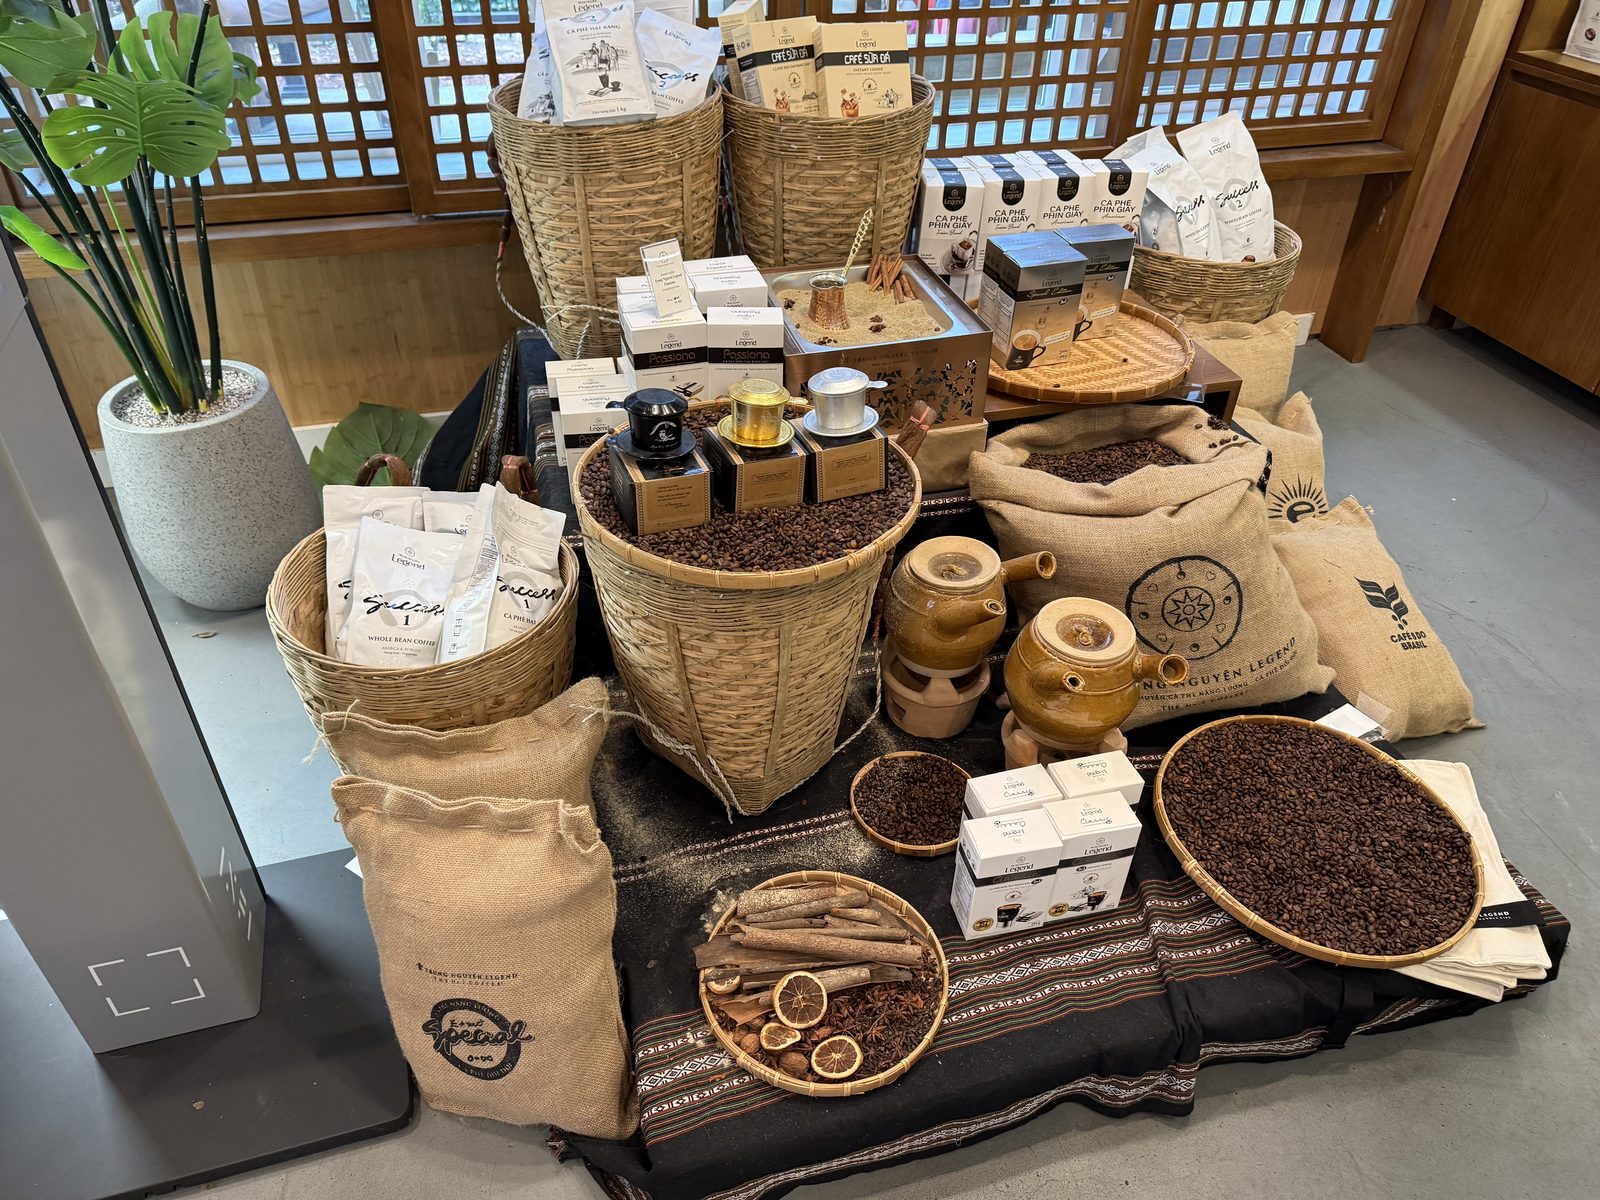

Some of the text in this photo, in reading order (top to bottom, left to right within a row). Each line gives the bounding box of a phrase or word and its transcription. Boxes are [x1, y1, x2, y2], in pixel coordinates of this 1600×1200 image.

[778, 37, 795, 46] Legend
[771, 48, 787, 63] CAFÉ
[844, 53, 862, 64] CAFÉ
[1209, 142, 1231, 156] Legend
[1154, 163, 1171, 176] Legend
[1236, 199, 1243, 208] 2
[987, 216, 1009, 224] PHIN
[660, 342, 682, 350] Legend
[649, 351, 696, 364] Passiona
[723, 349, 770, 360] Passiona
[391, 553, 425, 570] Legend
[524, 599, 530, 609] 1
[403, 614, 410, 626] 1
[413, 638, 435, 646] COFFEE
[1390, 630, 1427, 643] CAFÉS DO
[1400, 640, 1427, 650] BRASIL
[1249, 636, 1296, 672] LEGEND
[1084, 845, 1113, 855] Legend
[1004, 863, 1034, 873] Legend
[424, 967, 448, 978] TRUNG
[485, 973, 518, 981] LEGEND
[422, 1018, 535, 1056] Special
